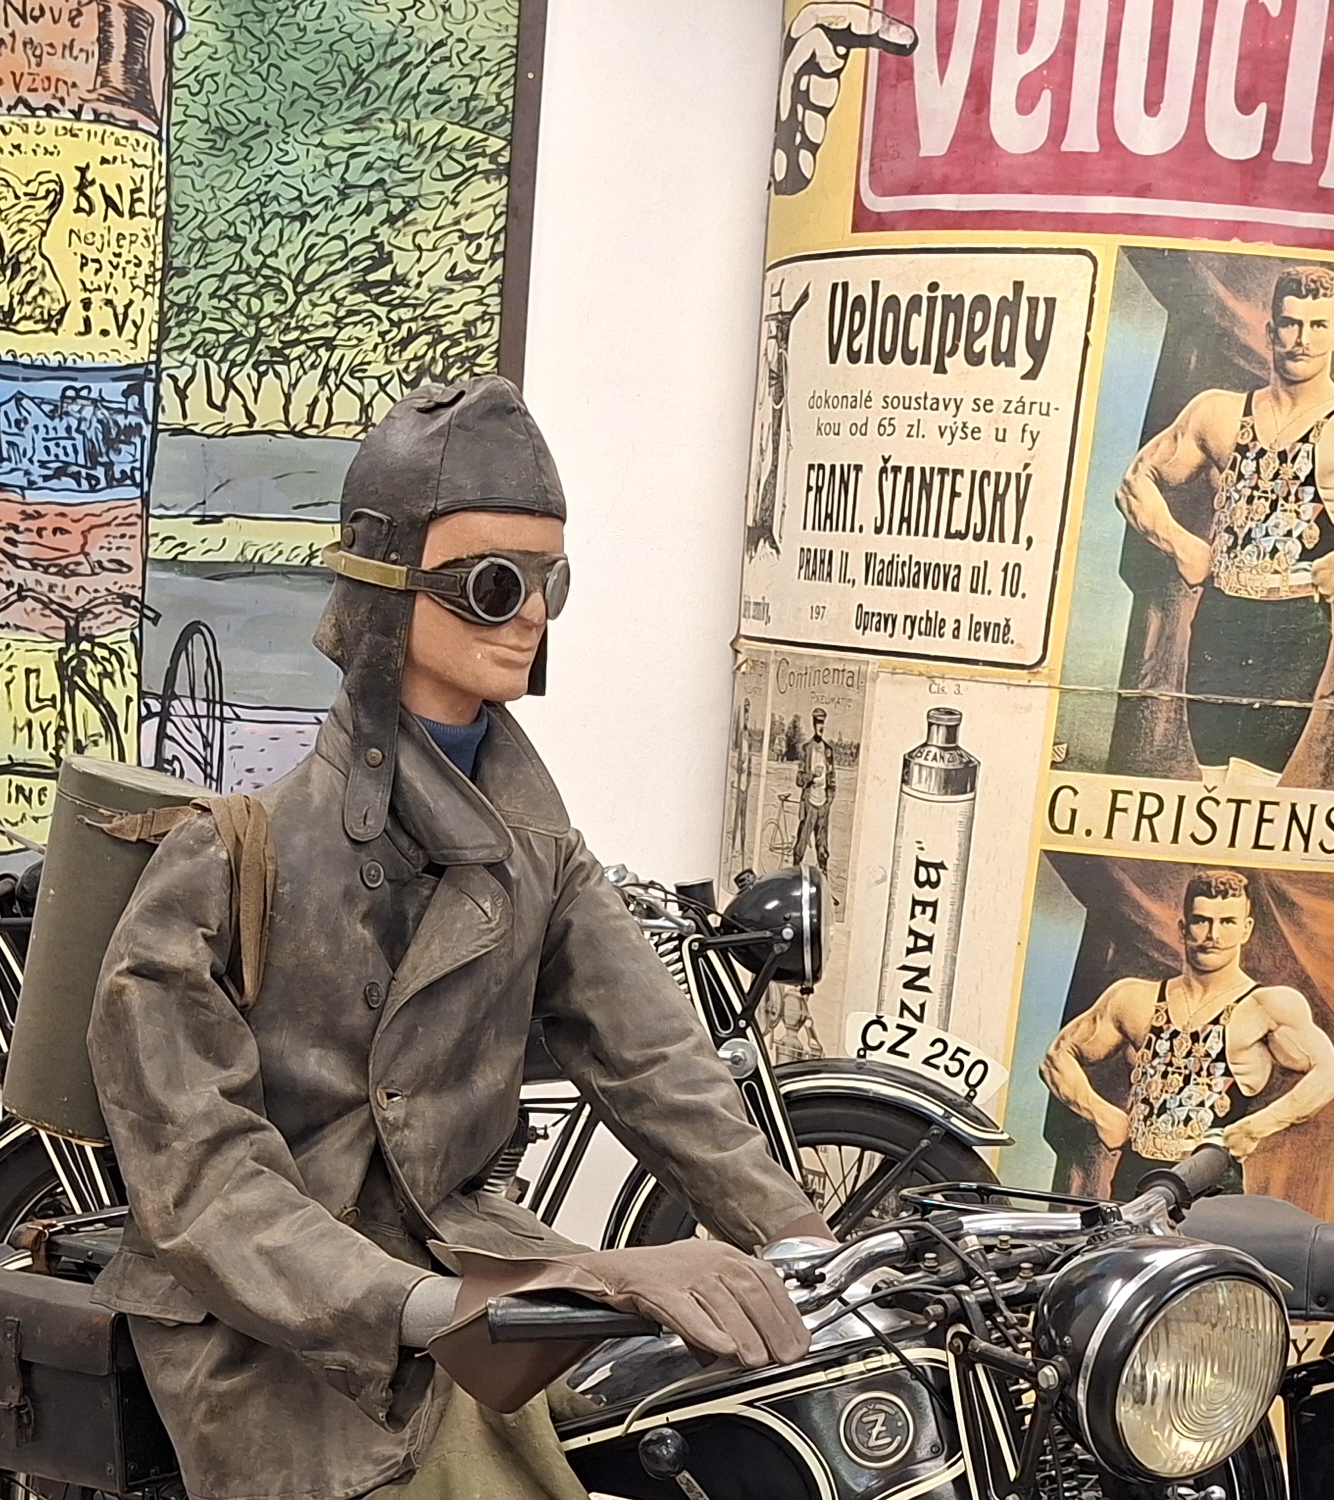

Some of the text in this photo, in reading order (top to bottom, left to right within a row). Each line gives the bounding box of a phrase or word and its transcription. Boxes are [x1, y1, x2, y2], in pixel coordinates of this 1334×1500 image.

[827, 279, 1058, 381] Velocipedy
[807, 389, 1060, 418] dokonalé soustavy se záru-
[816, 416, 1041, 451] kou od 65 zl. výše u fy
[802, 453, 1034, 551] FRANT. ŠTANTEJSKÝ,
[797, 546, 834, 584] PRAHA
[863, 551, 962, 594] Vladislavova
[969, 559, 993, 597] ul.
[1000, 561, 1028, 600] 10.
[809, 604, 828, 621] 197
[854, 602, 1016, 646] Opravy rychle a levně.
[1046, 783, 1098, 840] G.
[859, 1013, 989, 1090] ČZ 250
